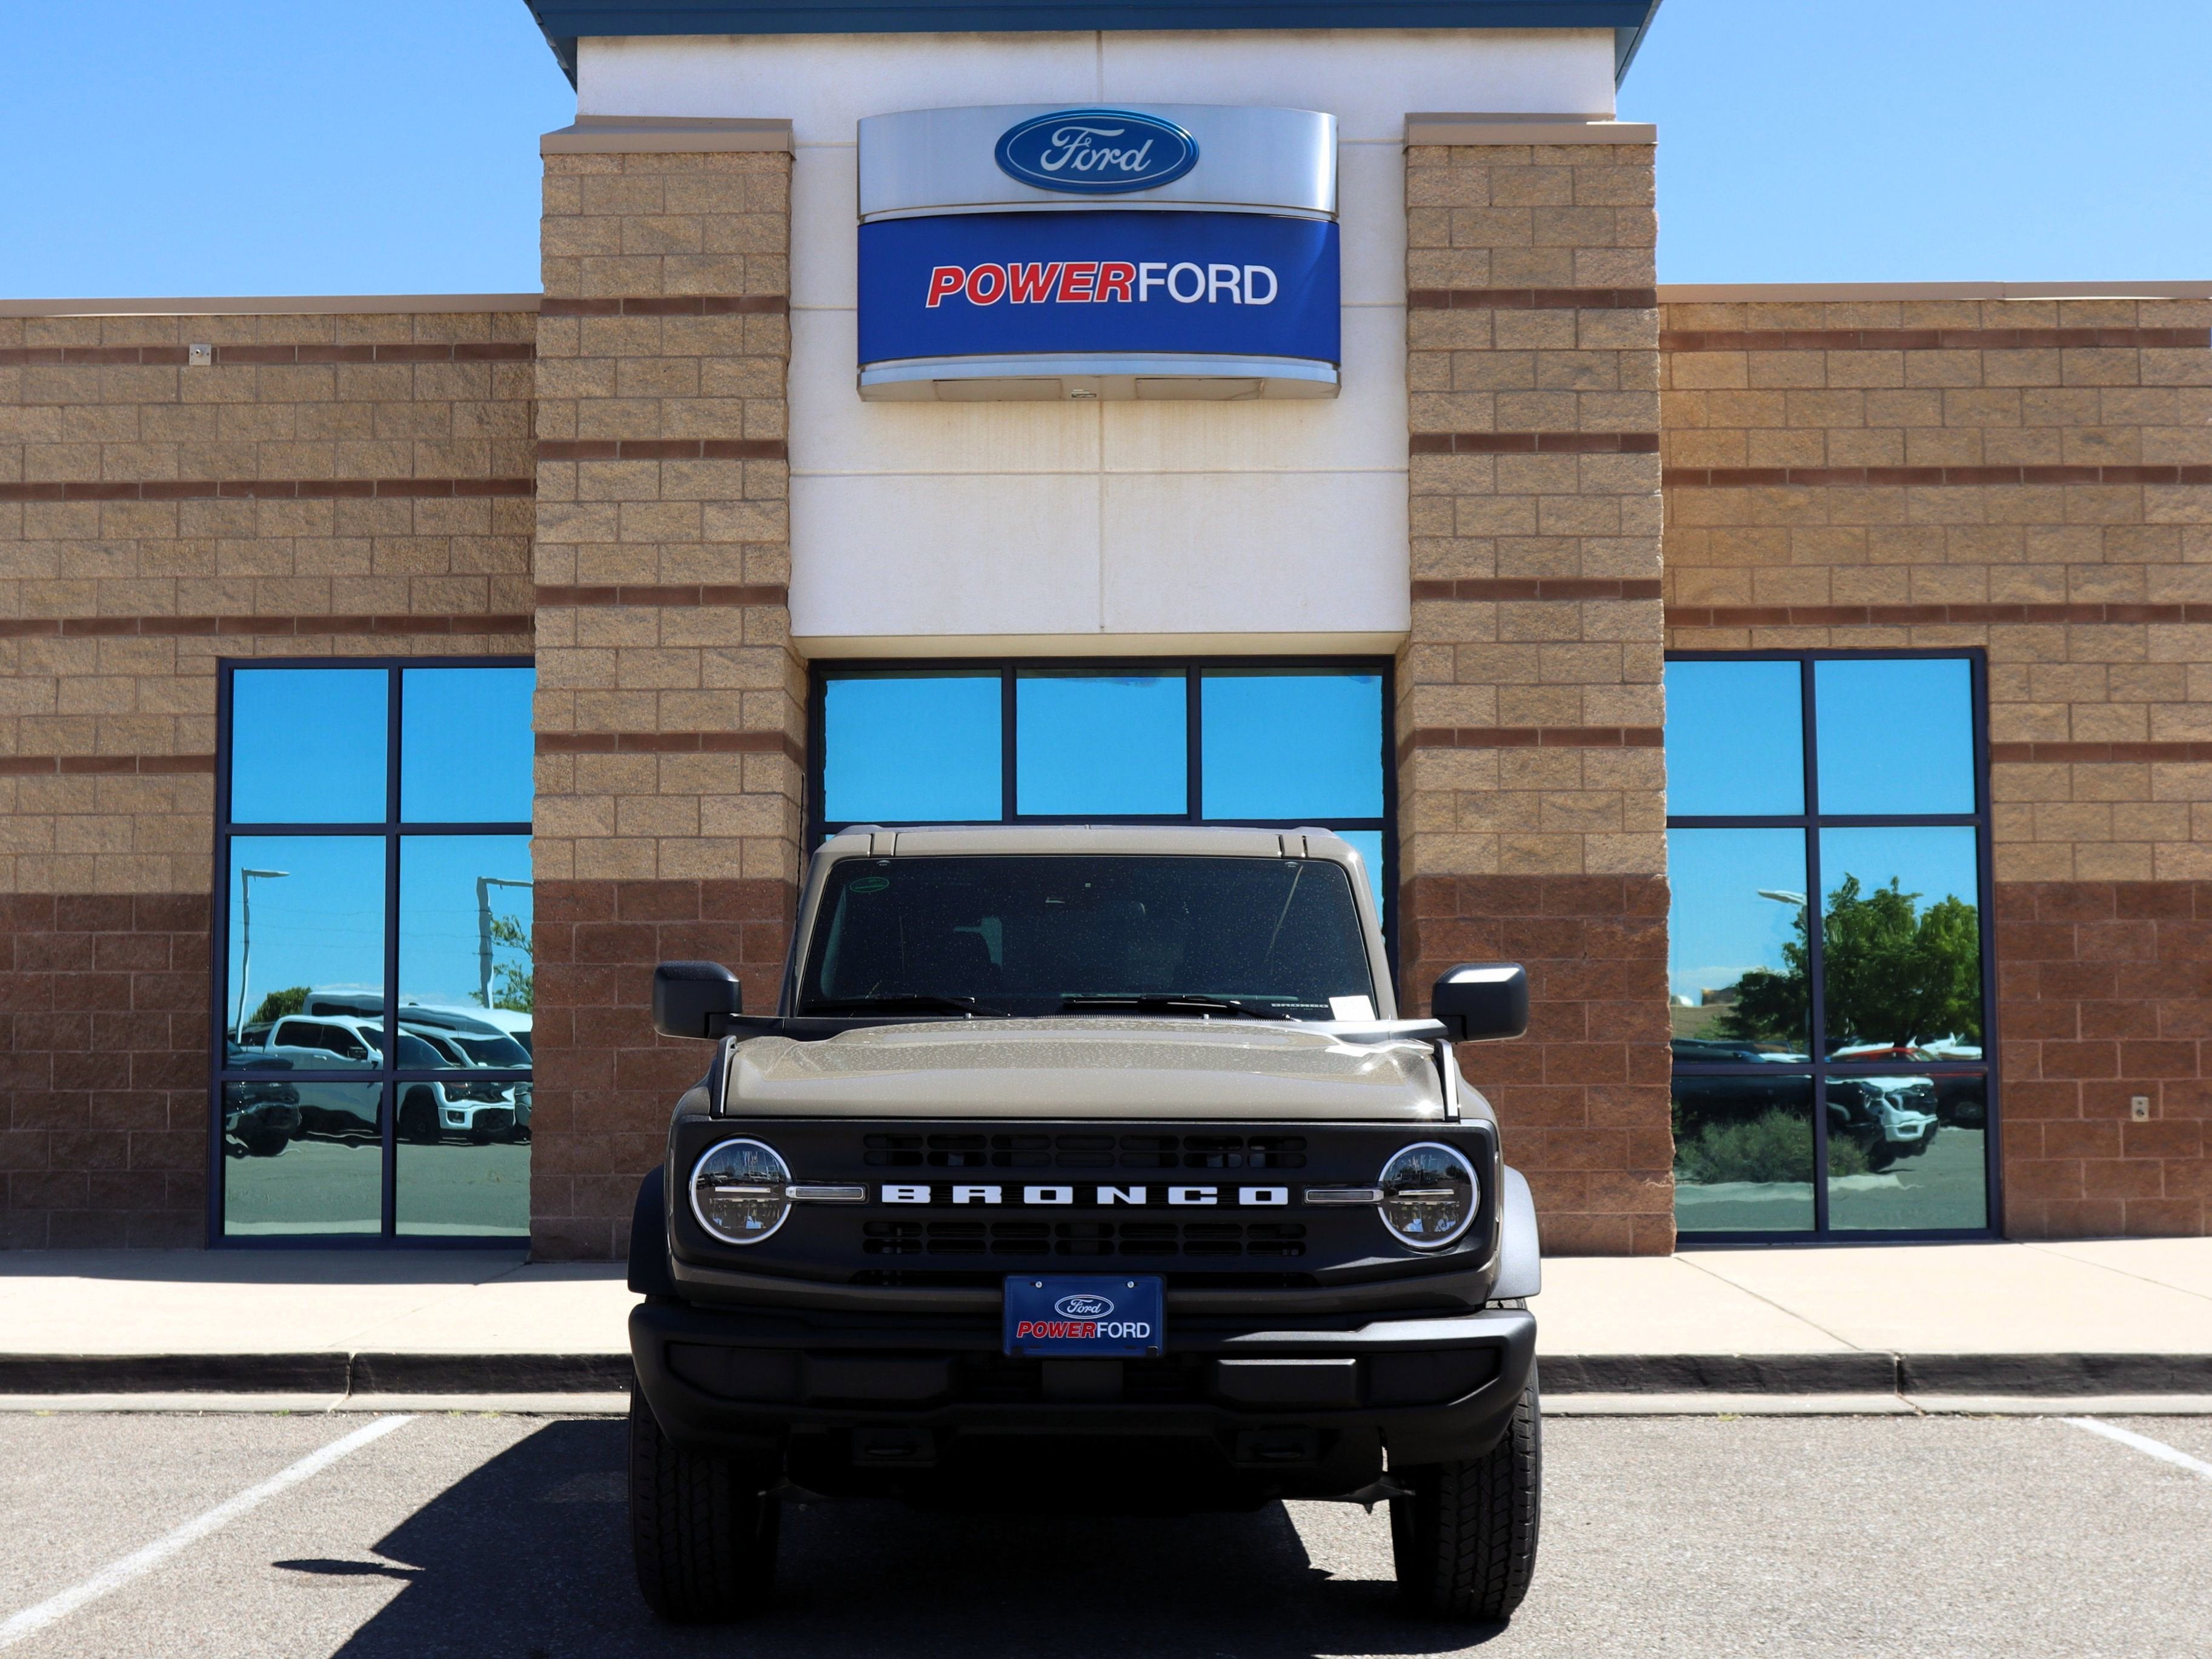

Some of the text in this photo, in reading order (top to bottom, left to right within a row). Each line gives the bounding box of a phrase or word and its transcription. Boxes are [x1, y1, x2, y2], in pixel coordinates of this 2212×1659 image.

[1040, 125, 1152, 172] Ford
[882, 1185, 1289, 1205] BRONCO
[1066, 1298, 1101, 1314] Ford
